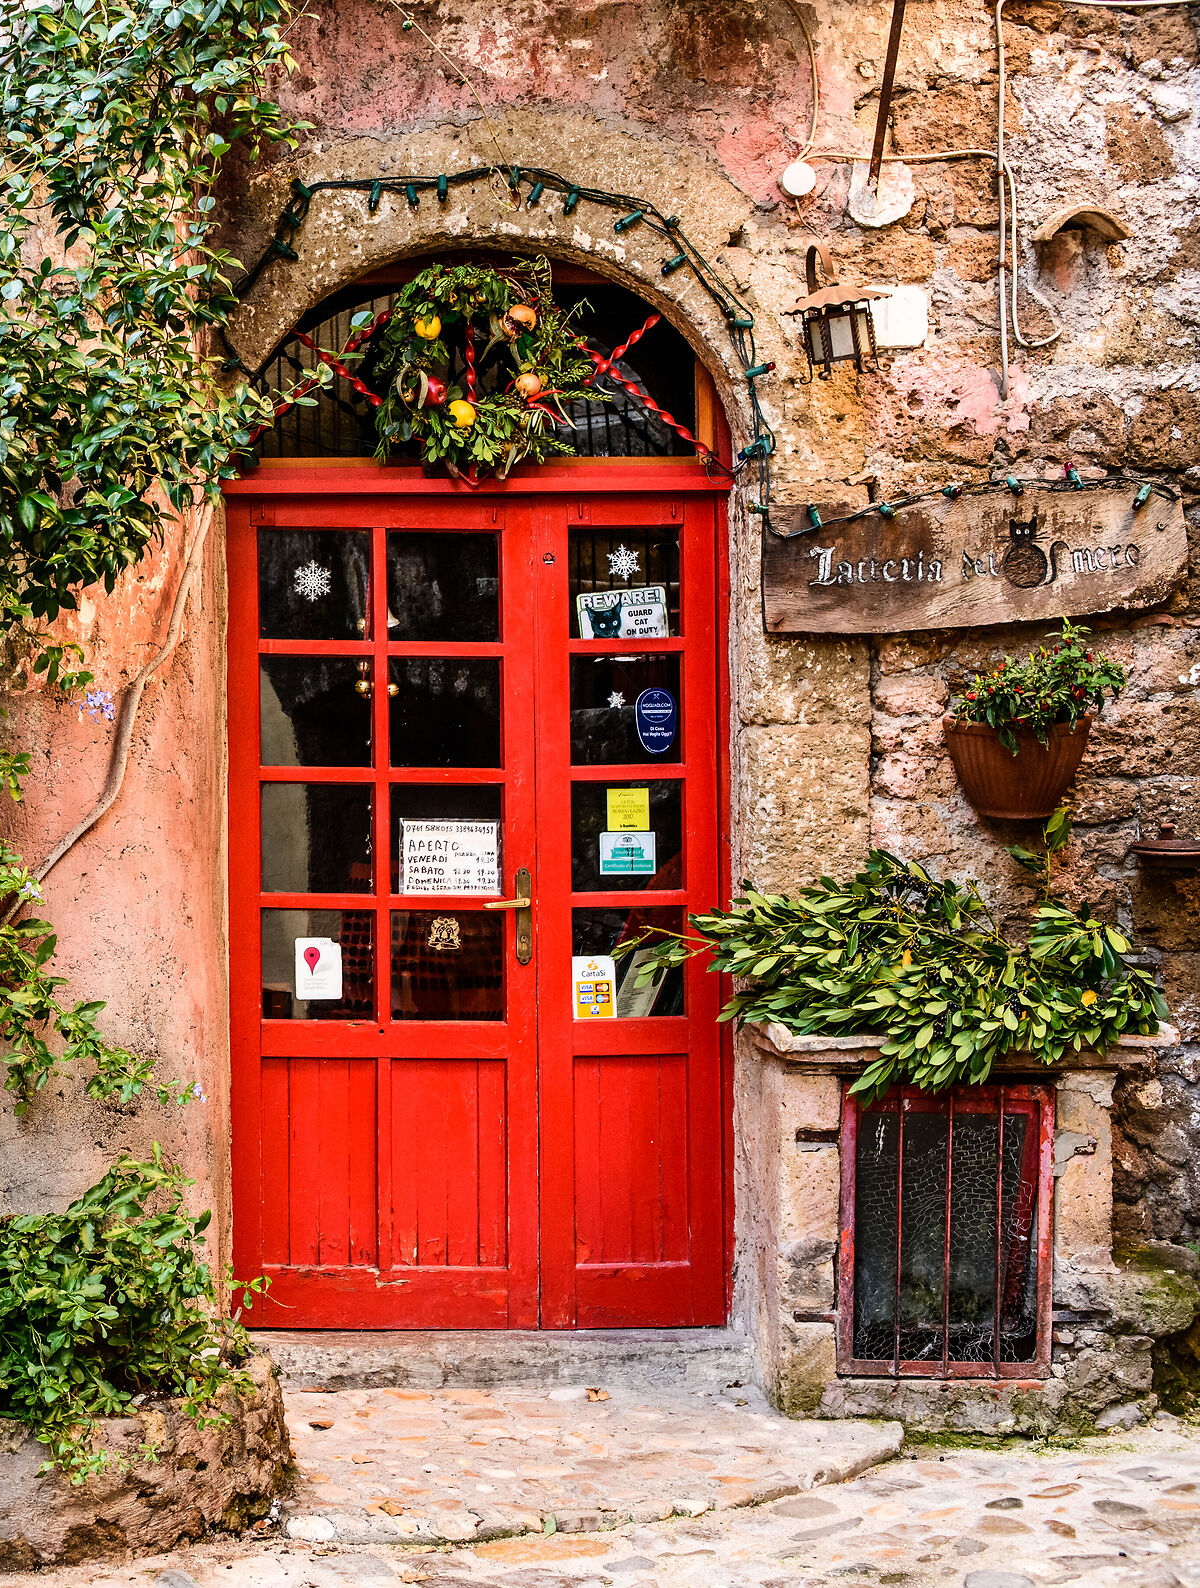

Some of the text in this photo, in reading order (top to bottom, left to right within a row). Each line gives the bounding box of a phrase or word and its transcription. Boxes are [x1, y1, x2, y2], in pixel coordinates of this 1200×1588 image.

[809, 545, 943, 586] Latteria
[961, 549, 1000, 582] del
[580, 589, 661, 609] BEWARE!
[628, 609, 653, 617] GUARD
[640, 627, 658, 635] DUTY
[408, 865, 445, 875] SABATO
